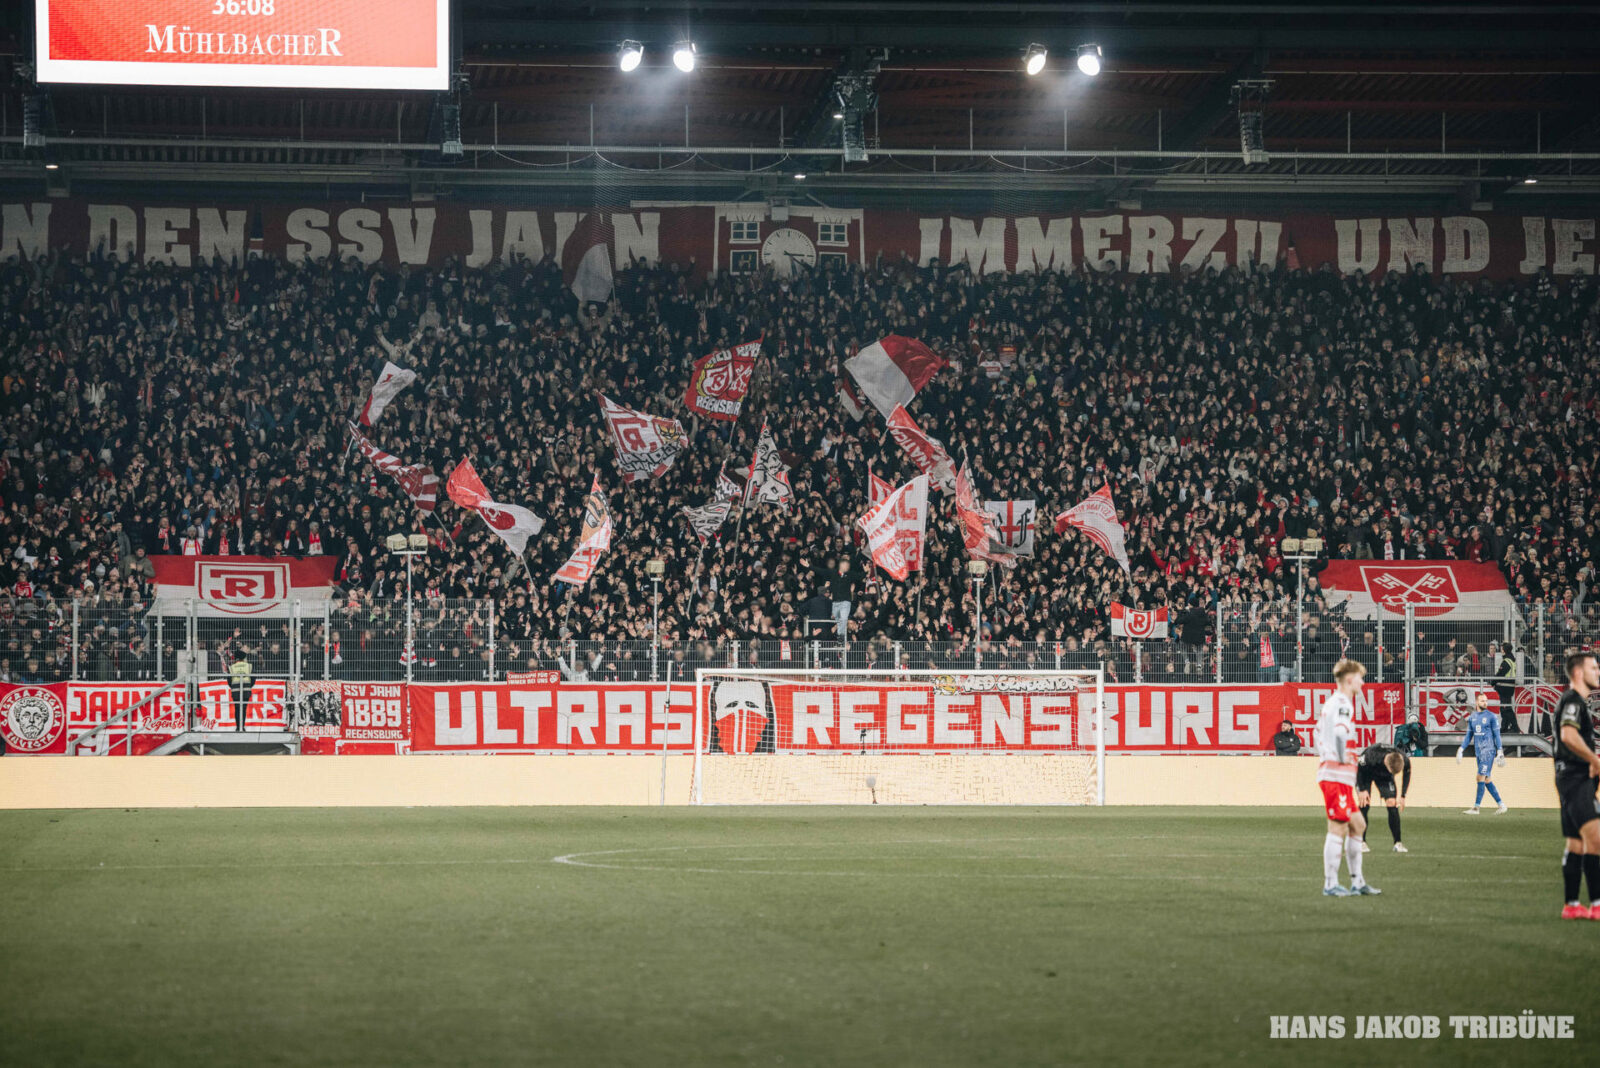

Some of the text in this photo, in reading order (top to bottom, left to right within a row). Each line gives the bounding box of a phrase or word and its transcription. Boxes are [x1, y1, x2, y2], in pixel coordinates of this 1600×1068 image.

[211, 0, 275, 16] 36:08
[145, 24, 343, 57] MÜHLBACHER
[87, 204, 247, 268] DEN
[286, 206, 437, 266] SSV
[919, 215, 1282, 275] IMMERZU
[1335, 216, 1490, 274] UND
[344, 684, 401, 698] SSV JAHN
[344, 698, 402, 727] 1889
[434, 691, 1260, 745] ULTRAS REGENSBURG
[345, 729, 404, 740] REGENSBURG
